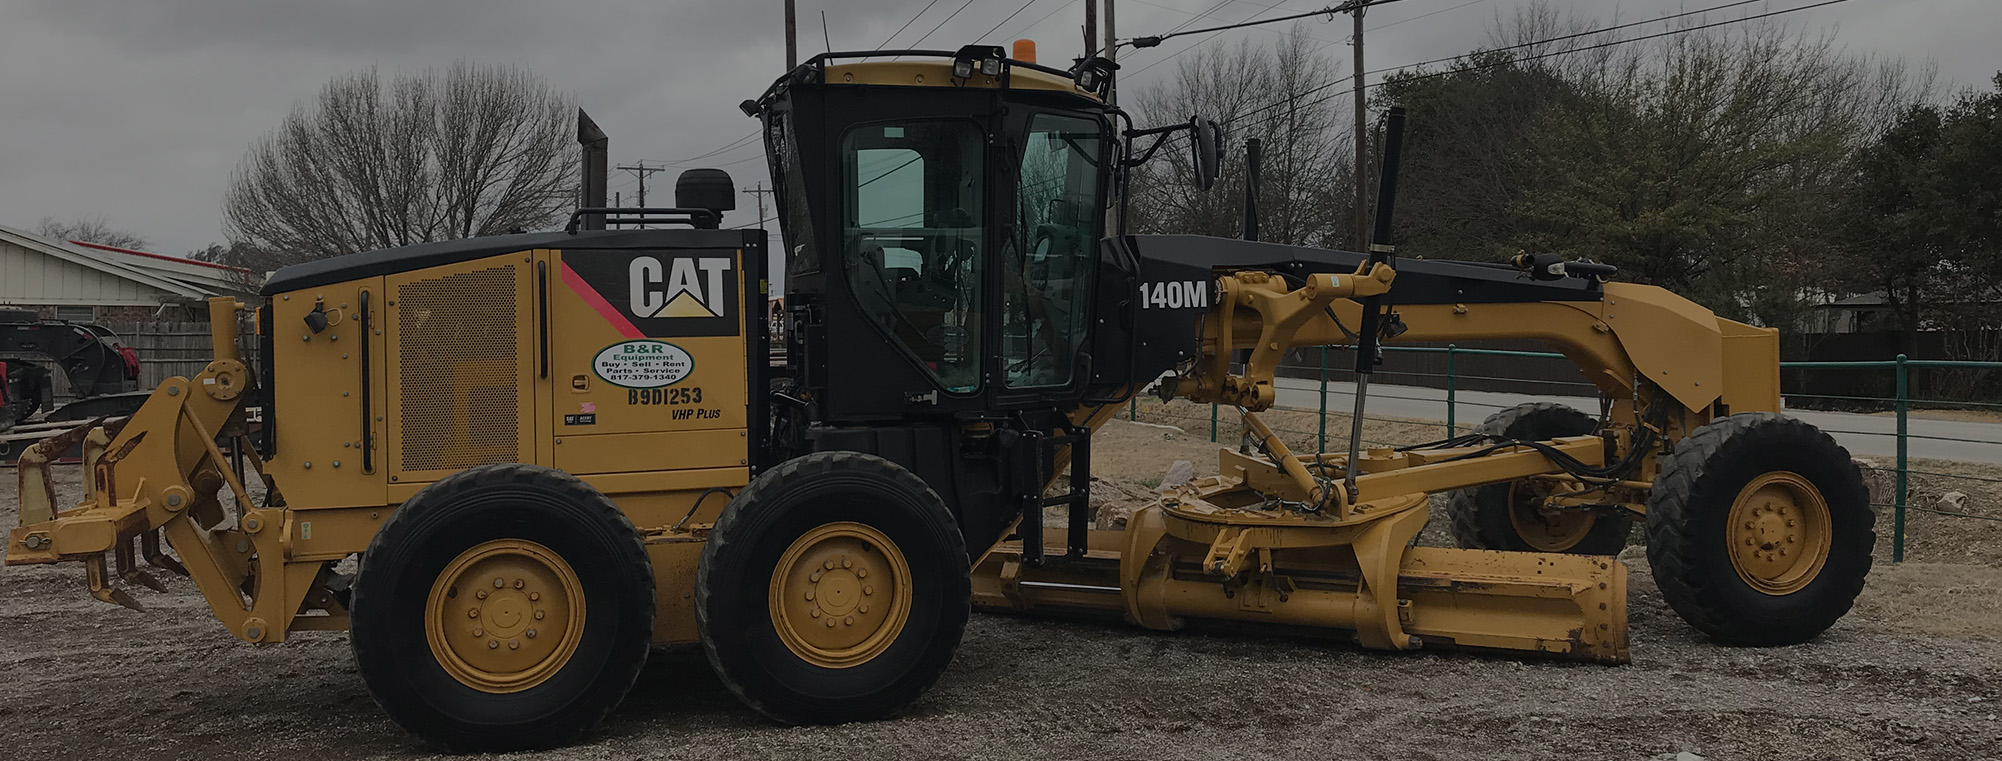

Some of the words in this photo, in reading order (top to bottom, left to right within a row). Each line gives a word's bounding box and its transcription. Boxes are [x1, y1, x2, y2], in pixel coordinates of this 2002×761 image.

[628, 255, 731, 318] CAT
[1139, 280, 1208, 309] 140M
[623, 344, 664, 354] B&R
[672, 408, 694, 420] VHP
[696, 408, 721, 419] PLUS
